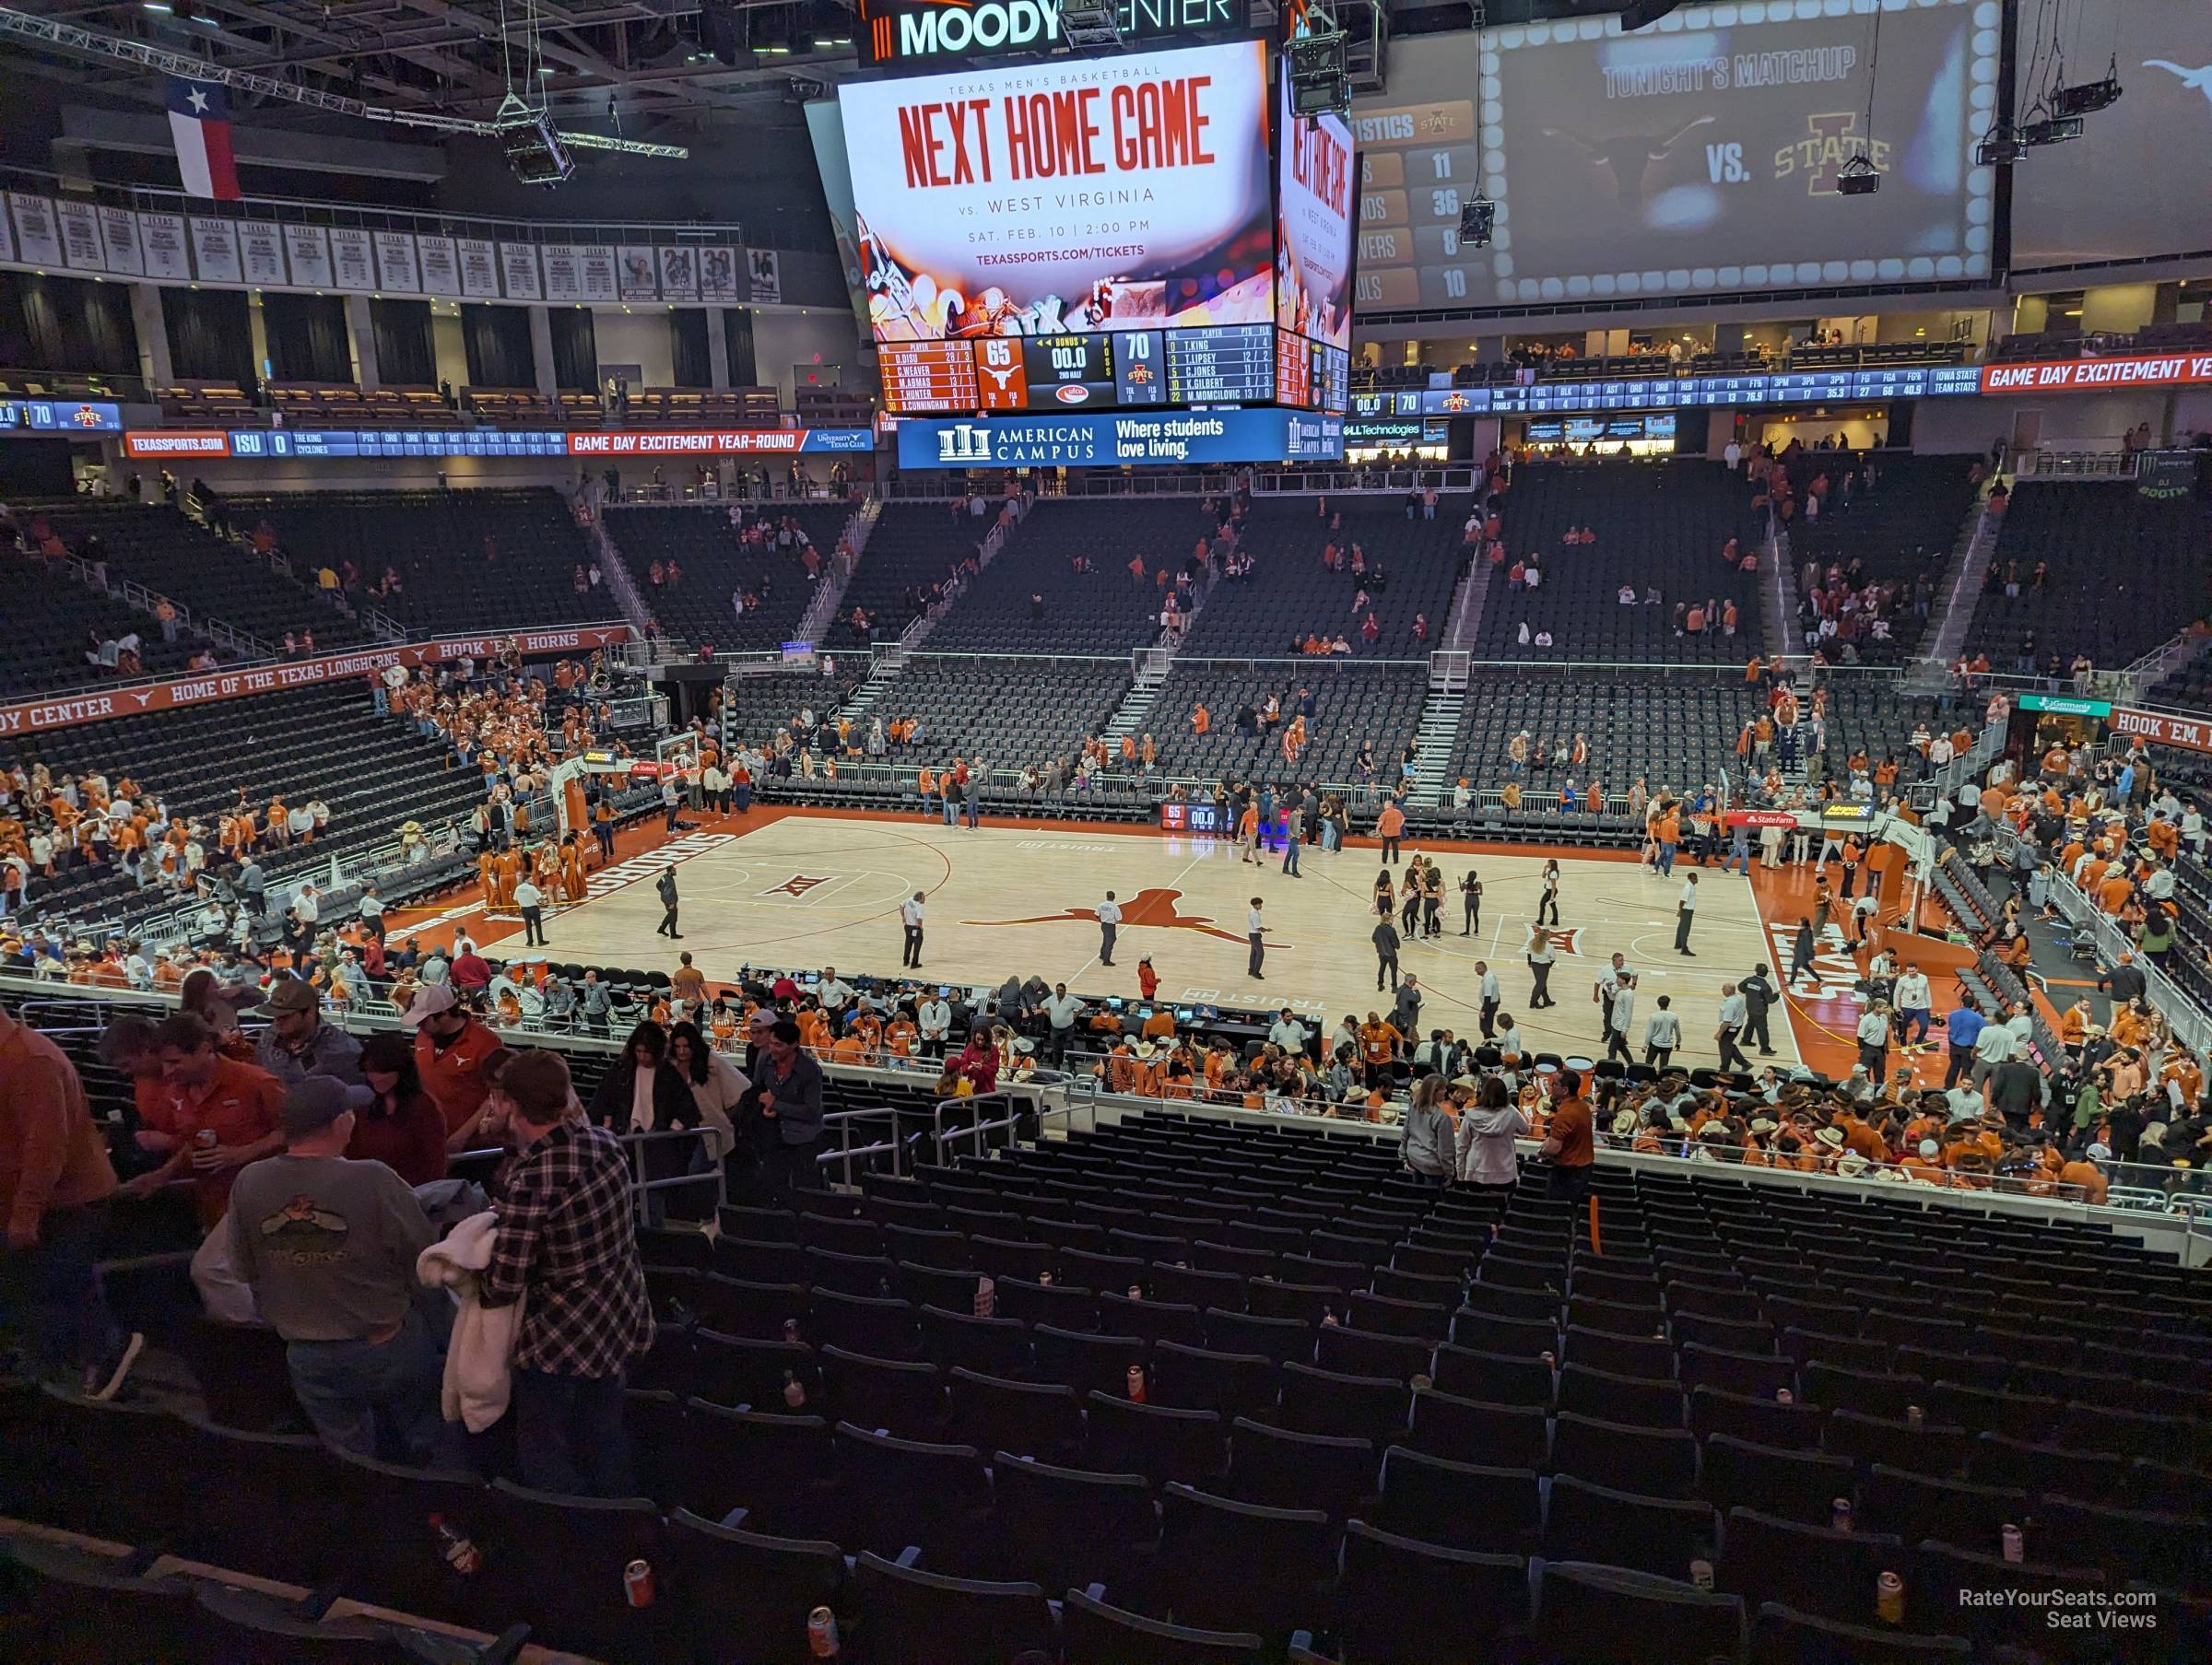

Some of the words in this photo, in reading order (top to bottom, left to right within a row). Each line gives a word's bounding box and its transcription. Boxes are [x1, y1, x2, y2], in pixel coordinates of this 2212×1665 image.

[900, 0, 1062, 56] MOODY
[1603, 56, 1729, 100] TONIGHT'S
[1735, 45, 1857, 88] MATCHUP
[949, 83, 995, 97] TEXAS
[1005, 76, 1050, 90] MEN'S
[1060, 66, 1161, 86] BASKETBALL
[898, 98, 992, 189] NEXT
[1004, 88, 1106, 181] HOME
[1112, 76, 1215, 171] GAME
[1705, 142, 1750, 184] VS.
[1774, 135, 1890, 180] STATE
[1432, 152, 1452, 179] 11
[988, 196, 1043, 214] WEST
[1055, 188, 1154, 209] VIRGINIA
[1432, 189, 1459, 217] 36
[969, 230, 1001, 243] SAT.
[1008, 228, 1042, 240] FEB.
[1050, 227, 1065, 237] 10
[1086, 222, 1121, 236] 2:00
[1129, 220, 1150, 231] PM
[976, 245, 1145, 266] TEXASSPORTS.COM/TICKETS
[1443, 269, 1466, 298] 10
[1202, 329, 1223, 337] PLAYER
[1055, 336, 1079, 346] BONUS
[1125, 333, 1149, 359] 70
[1184, 341, 1208, 351] T.KING
[896, 352, 918, 363] D.DISU
[986, 340, 1011, 366] 65
[1052, 346, 1087, 369] 00.0
[1185, 353, 1216, 363] T.LIPSEY
[898, 365, 930, 376] C.WEAVER
[1127, 369, 1154, 381] STATE
[1186, 366, 1216, 376] C.JONES
[1860, 373, 1870, 383] FG
[1883, 371, 1896, 382] FGA
[1907, 370, 1922, 381] FG%
[1936, 371, 1955, 381] IOWA
[1956, 369, 1976, 381] STATE
[1989, 368, 2037, 387] GAME
[2039, 366, 2072, 385] DAY
[2075, 359, 2186, 383] EXCITEMENT
[899, 377, 931, 388] M.ABMAS
[1187, 378, 1224, 389] K.GILBERT
[1707, 381, 1715, 391] FT
[1726, 380, 1738, 390] FTA
[1748, 379, 1762, 389] FT%
[1774, 377, 1789, 387] 3PM
[1802, 376, 1816, 386] 3PA
[1830, 374, 1844, 385] 3P%
[1935, 383, 1954, 393] TEAM
[1955, 381, 1976, 392] STATS
[900, 389, 932, 400] T.HUNTER
[1171, 392, 1181, 402] 22
[1187, 389, 1241, 400] M.MOMCILOVIC
[1493, 391, 1504, 399] TOL
[1560, 387, 1572, 396] BLK
[1606, 384, 1618, 394] AST
[1803, 389, 1811, 399] 17
[1827, 388, 1844, 399] 35.3
[1859, 386, 1870, 397] 27
[1882, 385, 1894, 396] 66
[1903, 384, 1922, 395] 40.9
[902, 400, 949, 411] B.CUNNINGHAM
[1402, 395, 1417, 410] 70
[1492, 402, 1512, 411] FOULS
[33, 405, 51, 423] 70
[880, 422, 898, 431] TEAM
[1116, 420, 1160, 439] Where
[1163, 418, 1224, 437] students
[1361, 425, 1419, 437] Technologies
[295, 434, 306, 443] TRE
[307, 434, 321, 443] KING
[574, 436, 611, 451] GAME
[613, 436, 638, 451] DAY
[640, 435, 714, 450] EXCITEMENT
[718, 434, 794, 450] YEAR-ROUND
[996, 428, 1094, 443] AMERICAN
[132, 438, 223, 451] TEXASSPORTS.COM
[235, 435, 260, 452] ISU
[297, 445, 327, 454] CYCLONES
[1117, 441, 1144, 458] love
[996, 445, 1094, 460] CAMPUS
[526, 633, 578, 650] HORNS
[171, 681, 218, 702] HOME
[221, 677, 240, 694] OF
[244, 672, 275, 690] THE
[278, 664, 324, 685] TEXAS
[29, 698, 113, 727] CENTER
[2117, 713, 2163, 737] HOOK
[2169, 722, 2201, 746] 'EM,
[1169, 806, 1180, 818] 65
[1192, 812, 1215, 826] 00.0
